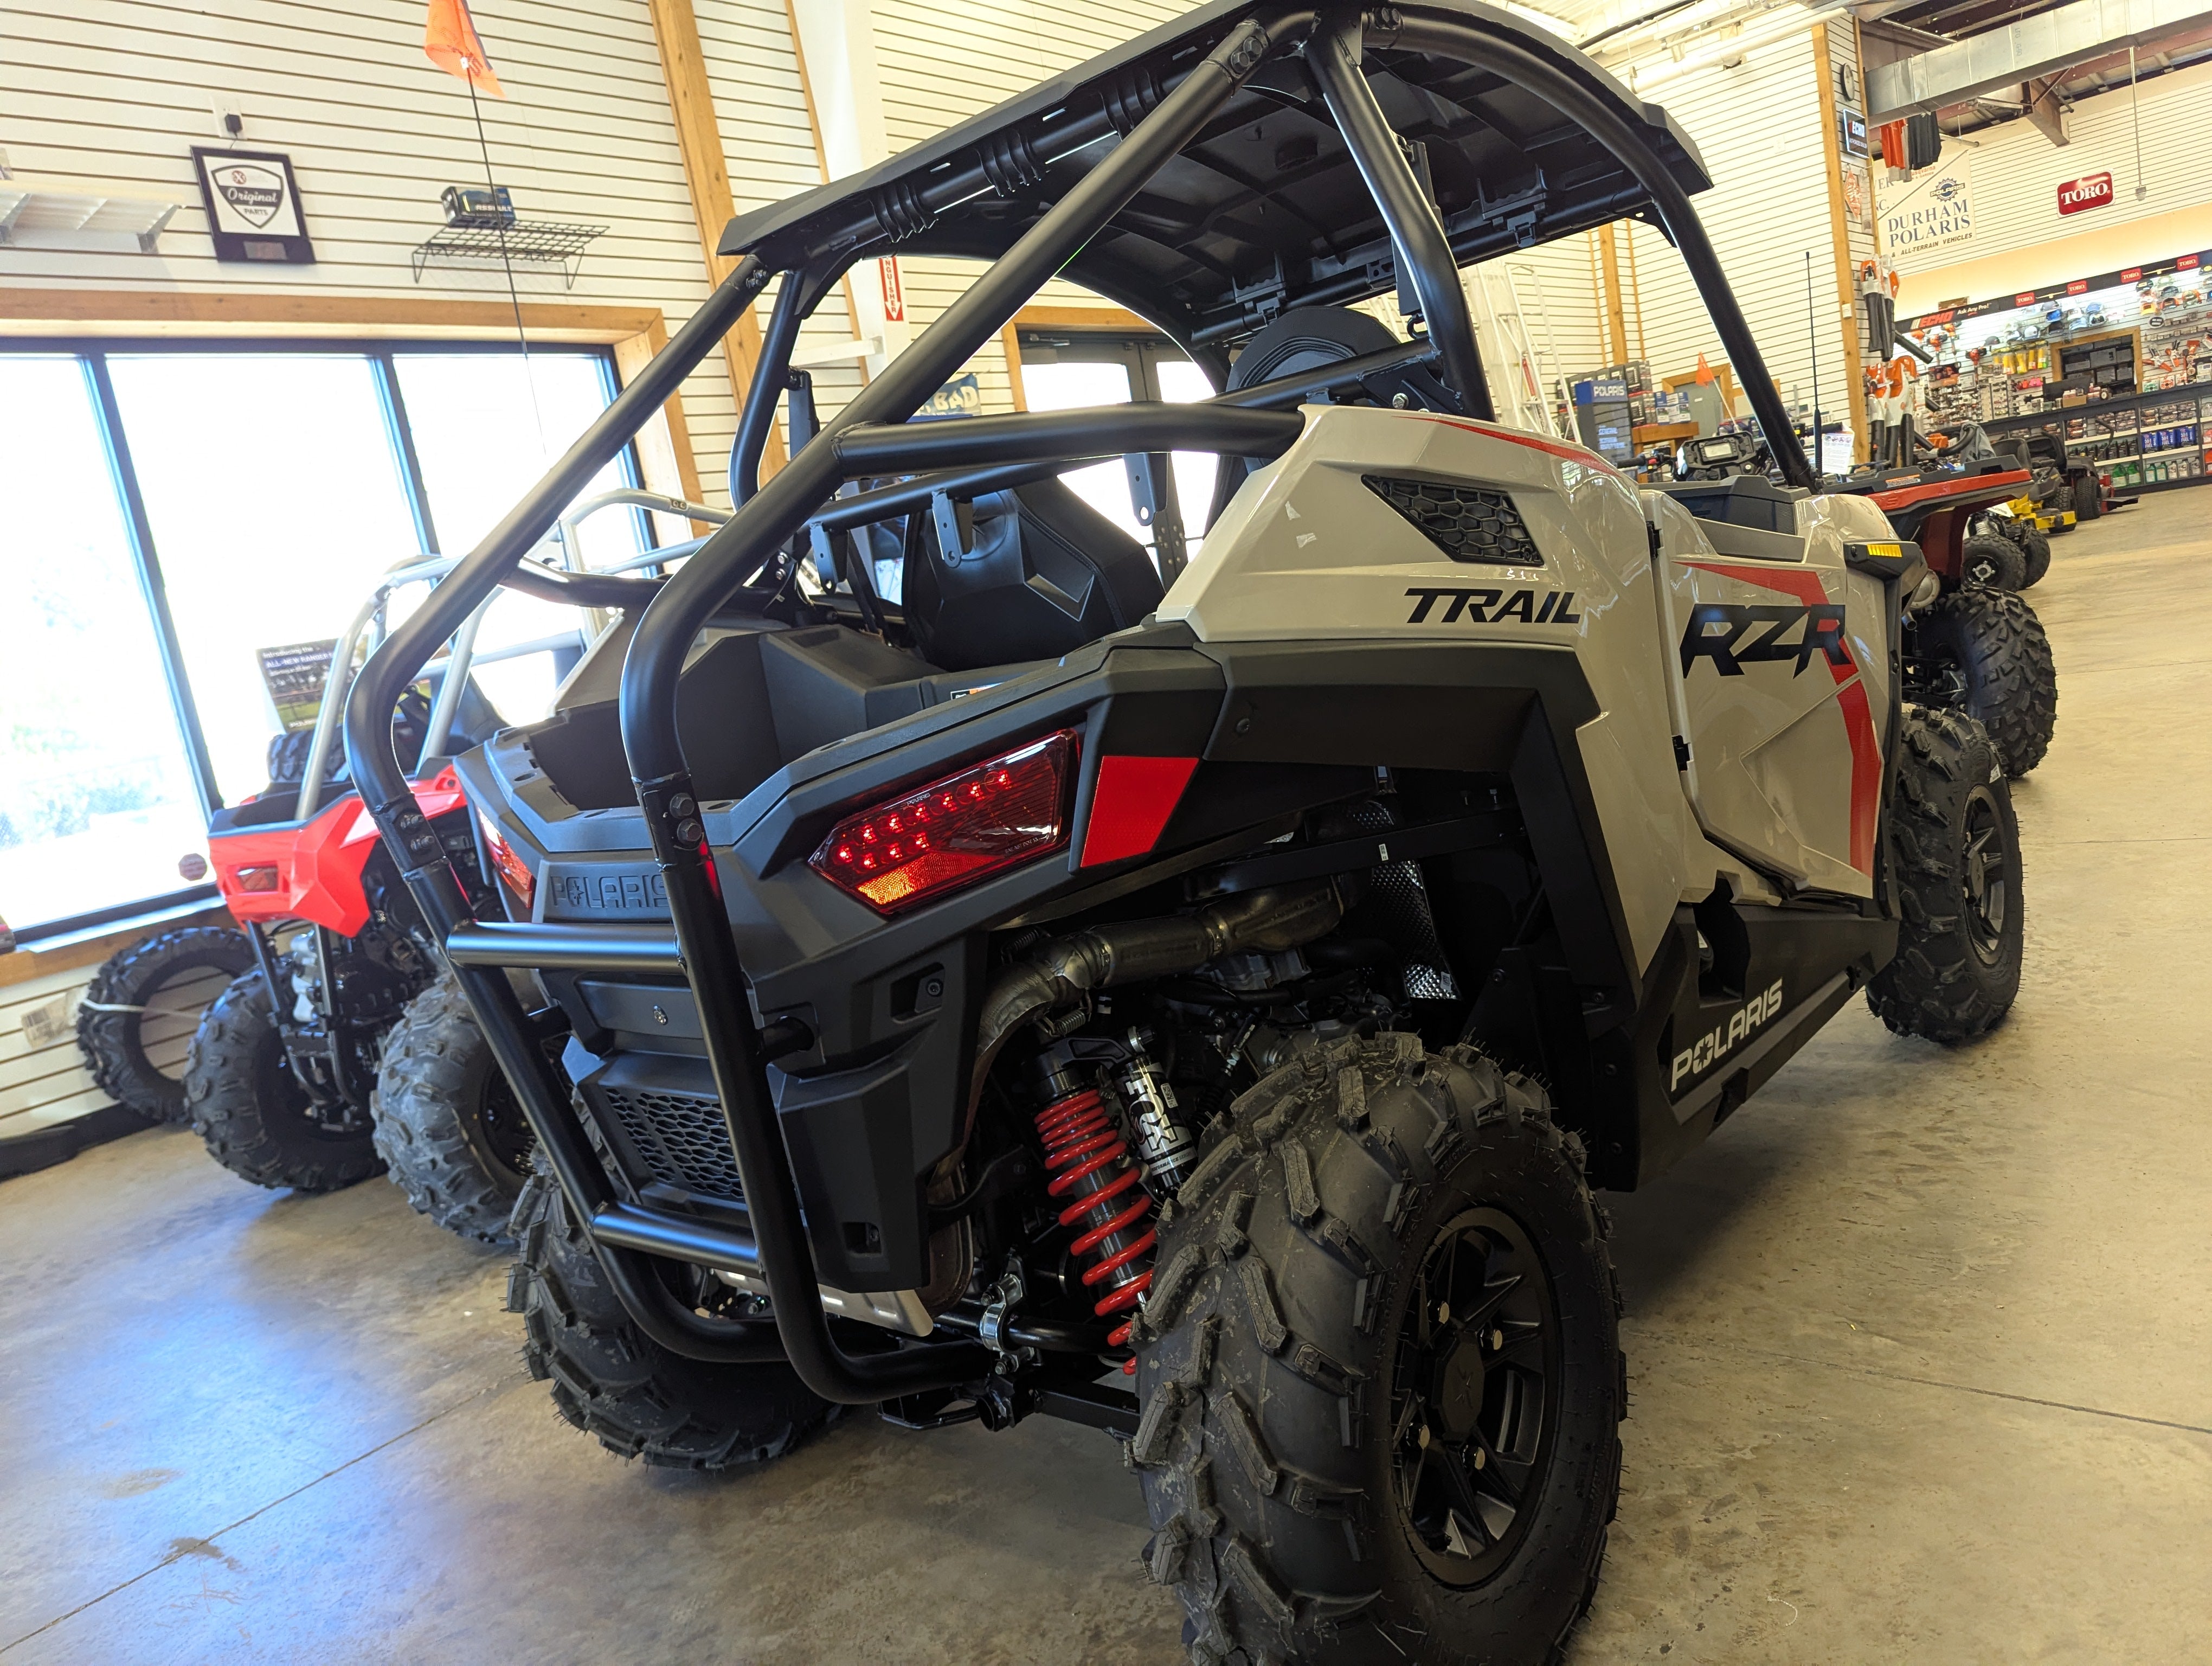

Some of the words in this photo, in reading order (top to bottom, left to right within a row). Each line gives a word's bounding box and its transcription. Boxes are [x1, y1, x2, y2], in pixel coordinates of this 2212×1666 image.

[1852, 121, 1865, 138] ECHO
[1911, 165, 1935, 175] usqvarna
[227, 188, 278, 205] Original
[1931, 184, 1964, 197] POLARIS
[2061, 183, 2108, 205] TORO
[244, 208, 268, 216] PARTS
[476, 204, 512, 212] ASSULT
[1888, 199, 1968, 232] DURHAM
[1890, 215, 1970, 247] POLARIS
[1901, 241, 1939, 255] ALL-TERRAIN
[1943, 233, 1972, 244] VEHICLES
[1919, 311, 1954, 327] ECHO
[934, 386, 978, 411] BAD
[1593, 386, 1625, 397] POLARIS
[1405, 588, 1581, 623] TRAIL
[1679, 603, 1852, 679] RZR
[906, 793, 930, 806] POLARIS
[550, 874, 671, 908] POLARIS
[1671, 977, 1783, 1092] POLARIS
[1124, 1072, 1179, 1152] FOX
